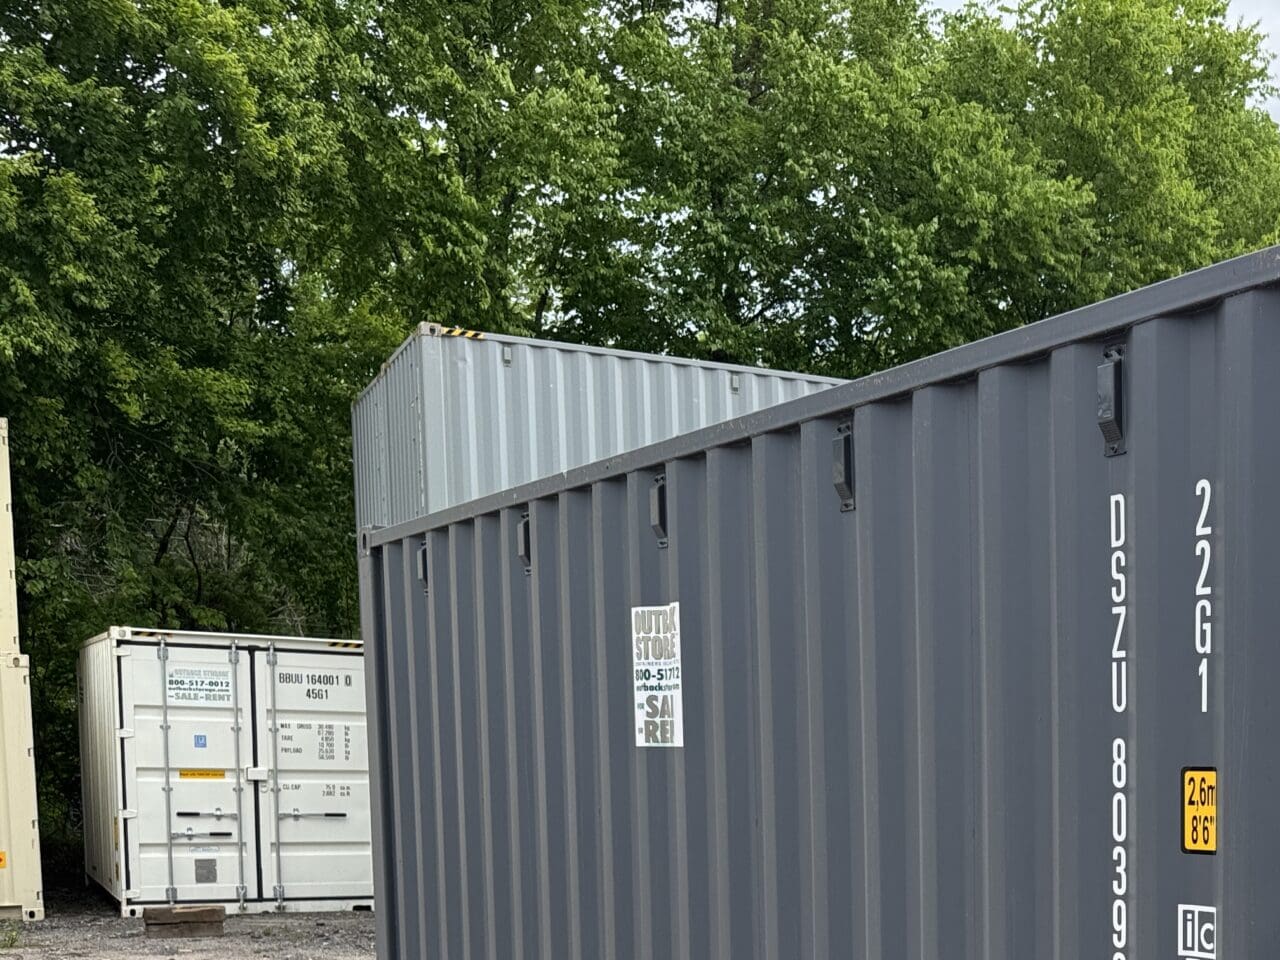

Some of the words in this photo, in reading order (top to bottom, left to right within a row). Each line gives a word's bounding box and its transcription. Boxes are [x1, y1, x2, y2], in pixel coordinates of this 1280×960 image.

[1110, 493, 1127, 712] DSZU
[1195, 479, 1212, 712] 22G1
[168, 679, 230, 687] 800-517-0012
[279, 672, 303, 684] BBUU
[306, 674, 339, 686] 164001
[306, 689, 329, 700] 45G1
